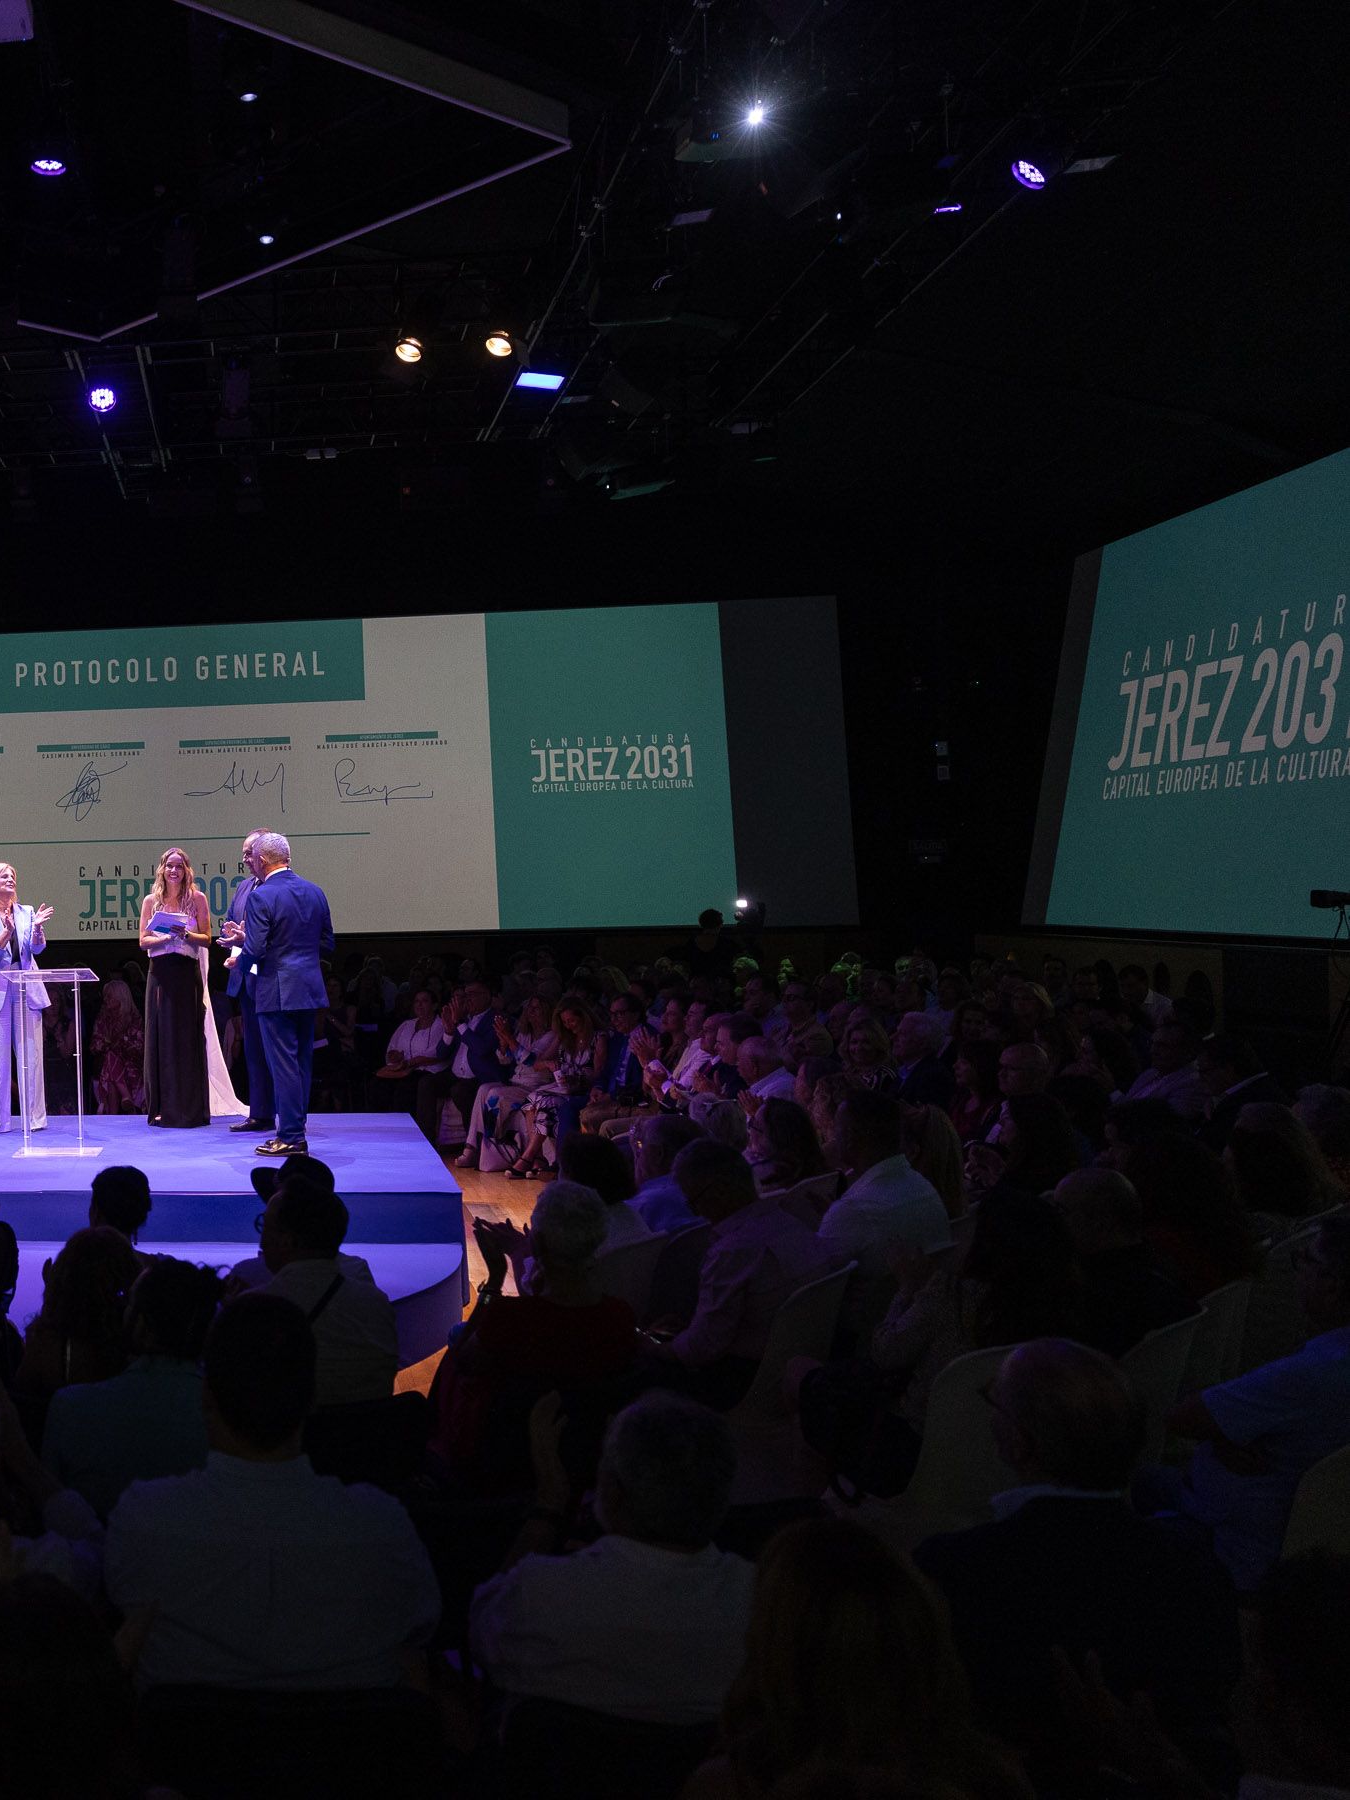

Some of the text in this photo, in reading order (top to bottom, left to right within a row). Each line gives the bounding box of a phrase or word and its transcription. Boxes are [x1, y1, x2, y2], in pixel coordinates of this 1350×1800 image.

[14, 650, 326, 687] PROTOCOLO GENERAL
[1107, 632, 1350, 771] JEREZ 203
[530, 733, 690, 748] CANDIDATURA
[531, 744, 693, 782] JEREZ 2031
[1102, 772, 1150, 800] CAPITAL
[1156, 764, 1218, 795] EUROPEA
[1224, 760, 1245, 788] DE
[1250, 756, 1270, 786] LA
[532, 779, 694, 793] CAPITAL EUROPEA DE LA CULTURA
[78, 879, 155, 919] JER
[79, 920, 122, 932] CAPITAL
